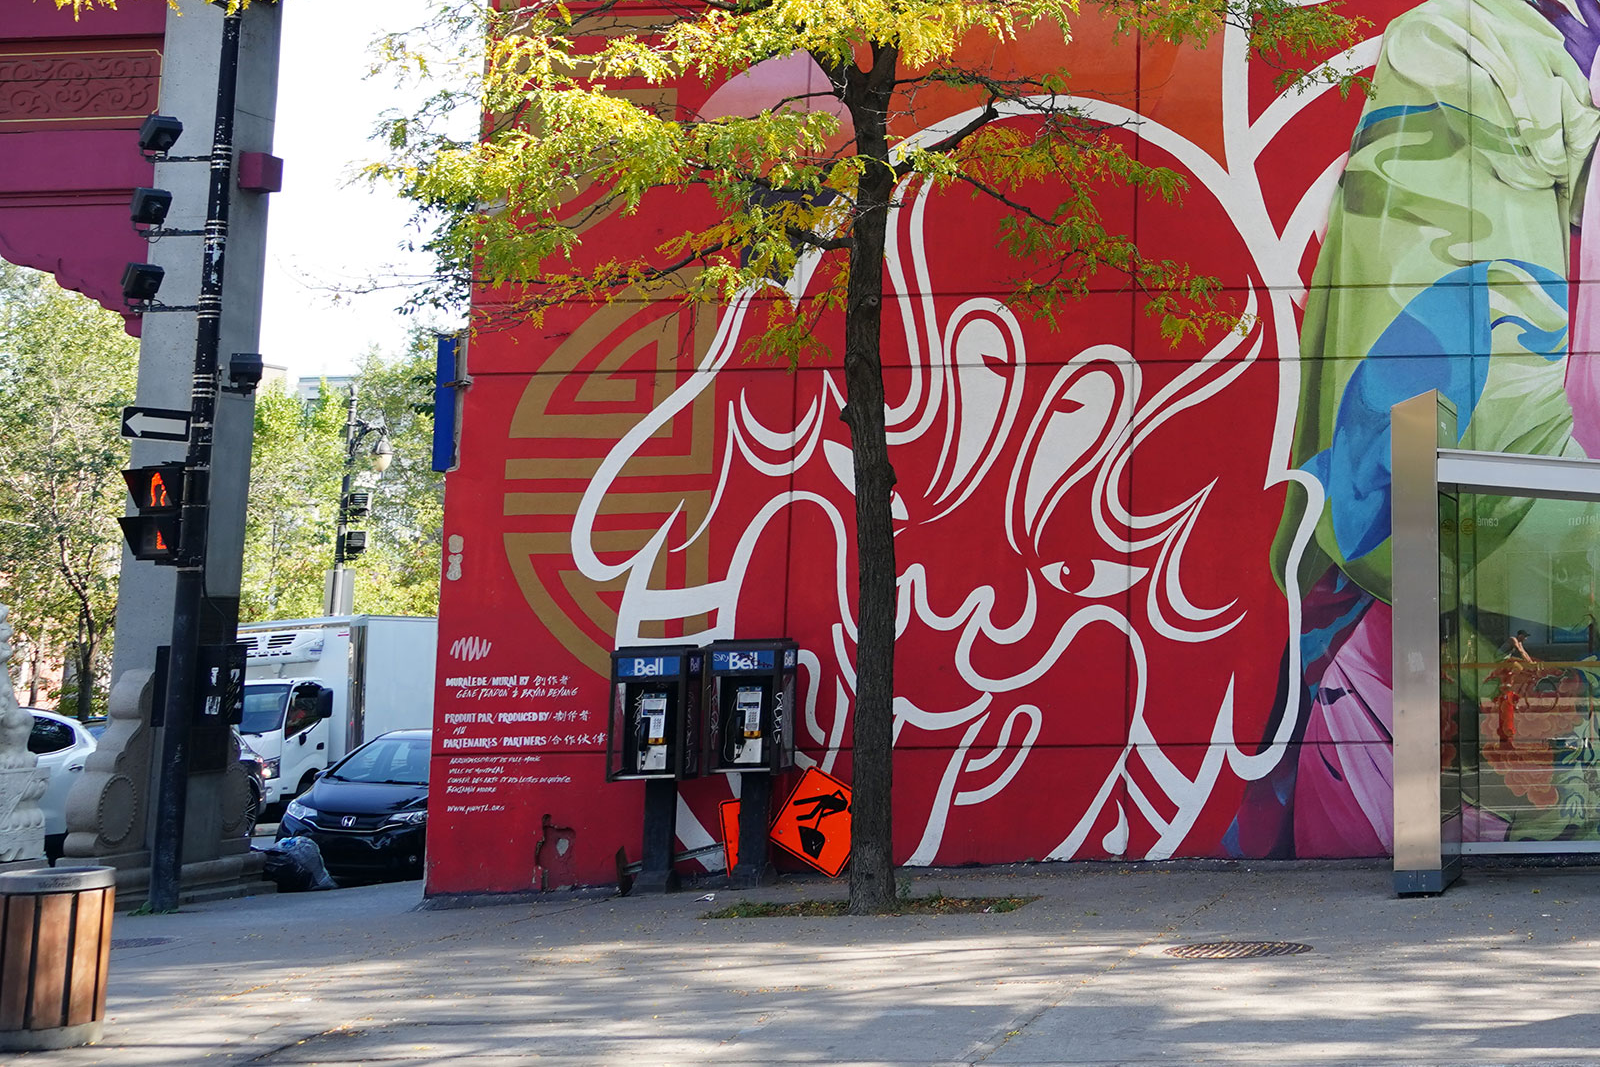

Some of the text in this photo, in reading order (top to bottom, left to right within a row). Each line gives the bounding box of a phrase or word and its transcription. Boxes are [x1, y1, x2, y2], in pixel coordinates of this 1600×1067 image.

[634, 658, 664, 676] Bell
[729, 651, 758, 670] Bell
[444, 713, 476, 725] PRODUIT
